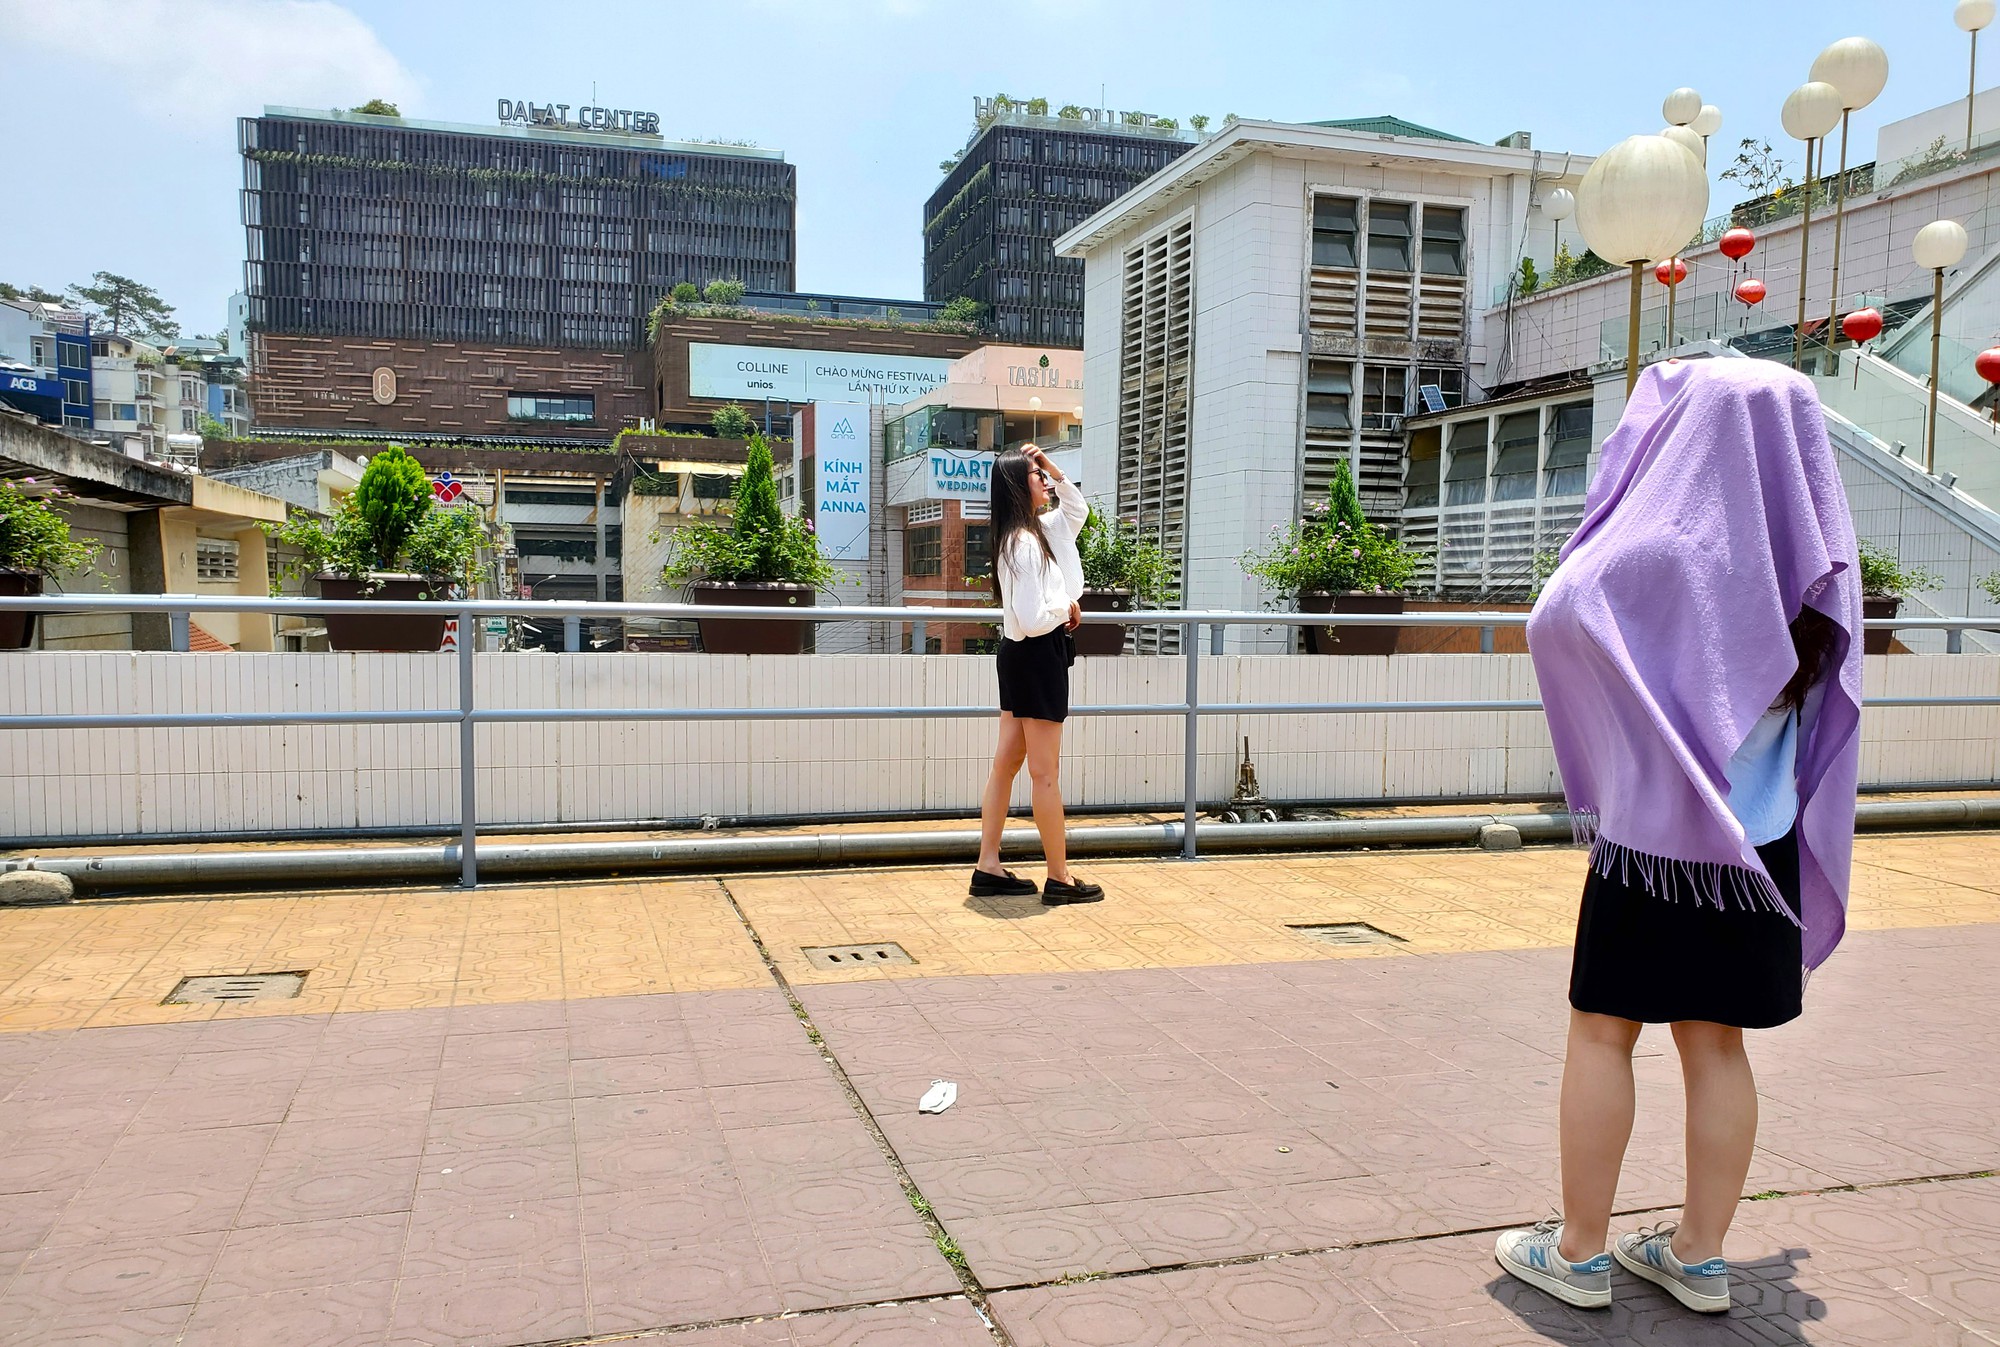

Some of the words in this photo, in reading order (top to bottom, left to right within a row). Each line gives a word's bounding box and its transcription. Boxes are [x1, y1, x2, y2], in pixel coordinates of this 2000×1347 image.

[498, 99, 570, 125] DALAT
[579, 107, 660, 133] CENTER
[737, 361, 789, 375] COLLINE
[815, 365, 848, 377] CHÀO
[851, 367, 884, 380] MỪNG
[887, 371, 936, 383] FESTIVAL
[1007, 366, 1060, 388] TASTY
[10, 377, 37, 391] ACB
[873, 382, 897, 394] THỨ
[899, 385, 910, 395] IX
[824, 458, 863, 474] KÍNH
[932, 457, 992, 478] TUART
[826, 475, 860, 494] MẮT
[937, 480, 987, 493] WEDDING
[820, 500, 867, 514] ANNA
[1529, 1245, 1548, 1269] N
[1645, 1243, 1663, 1267] N
